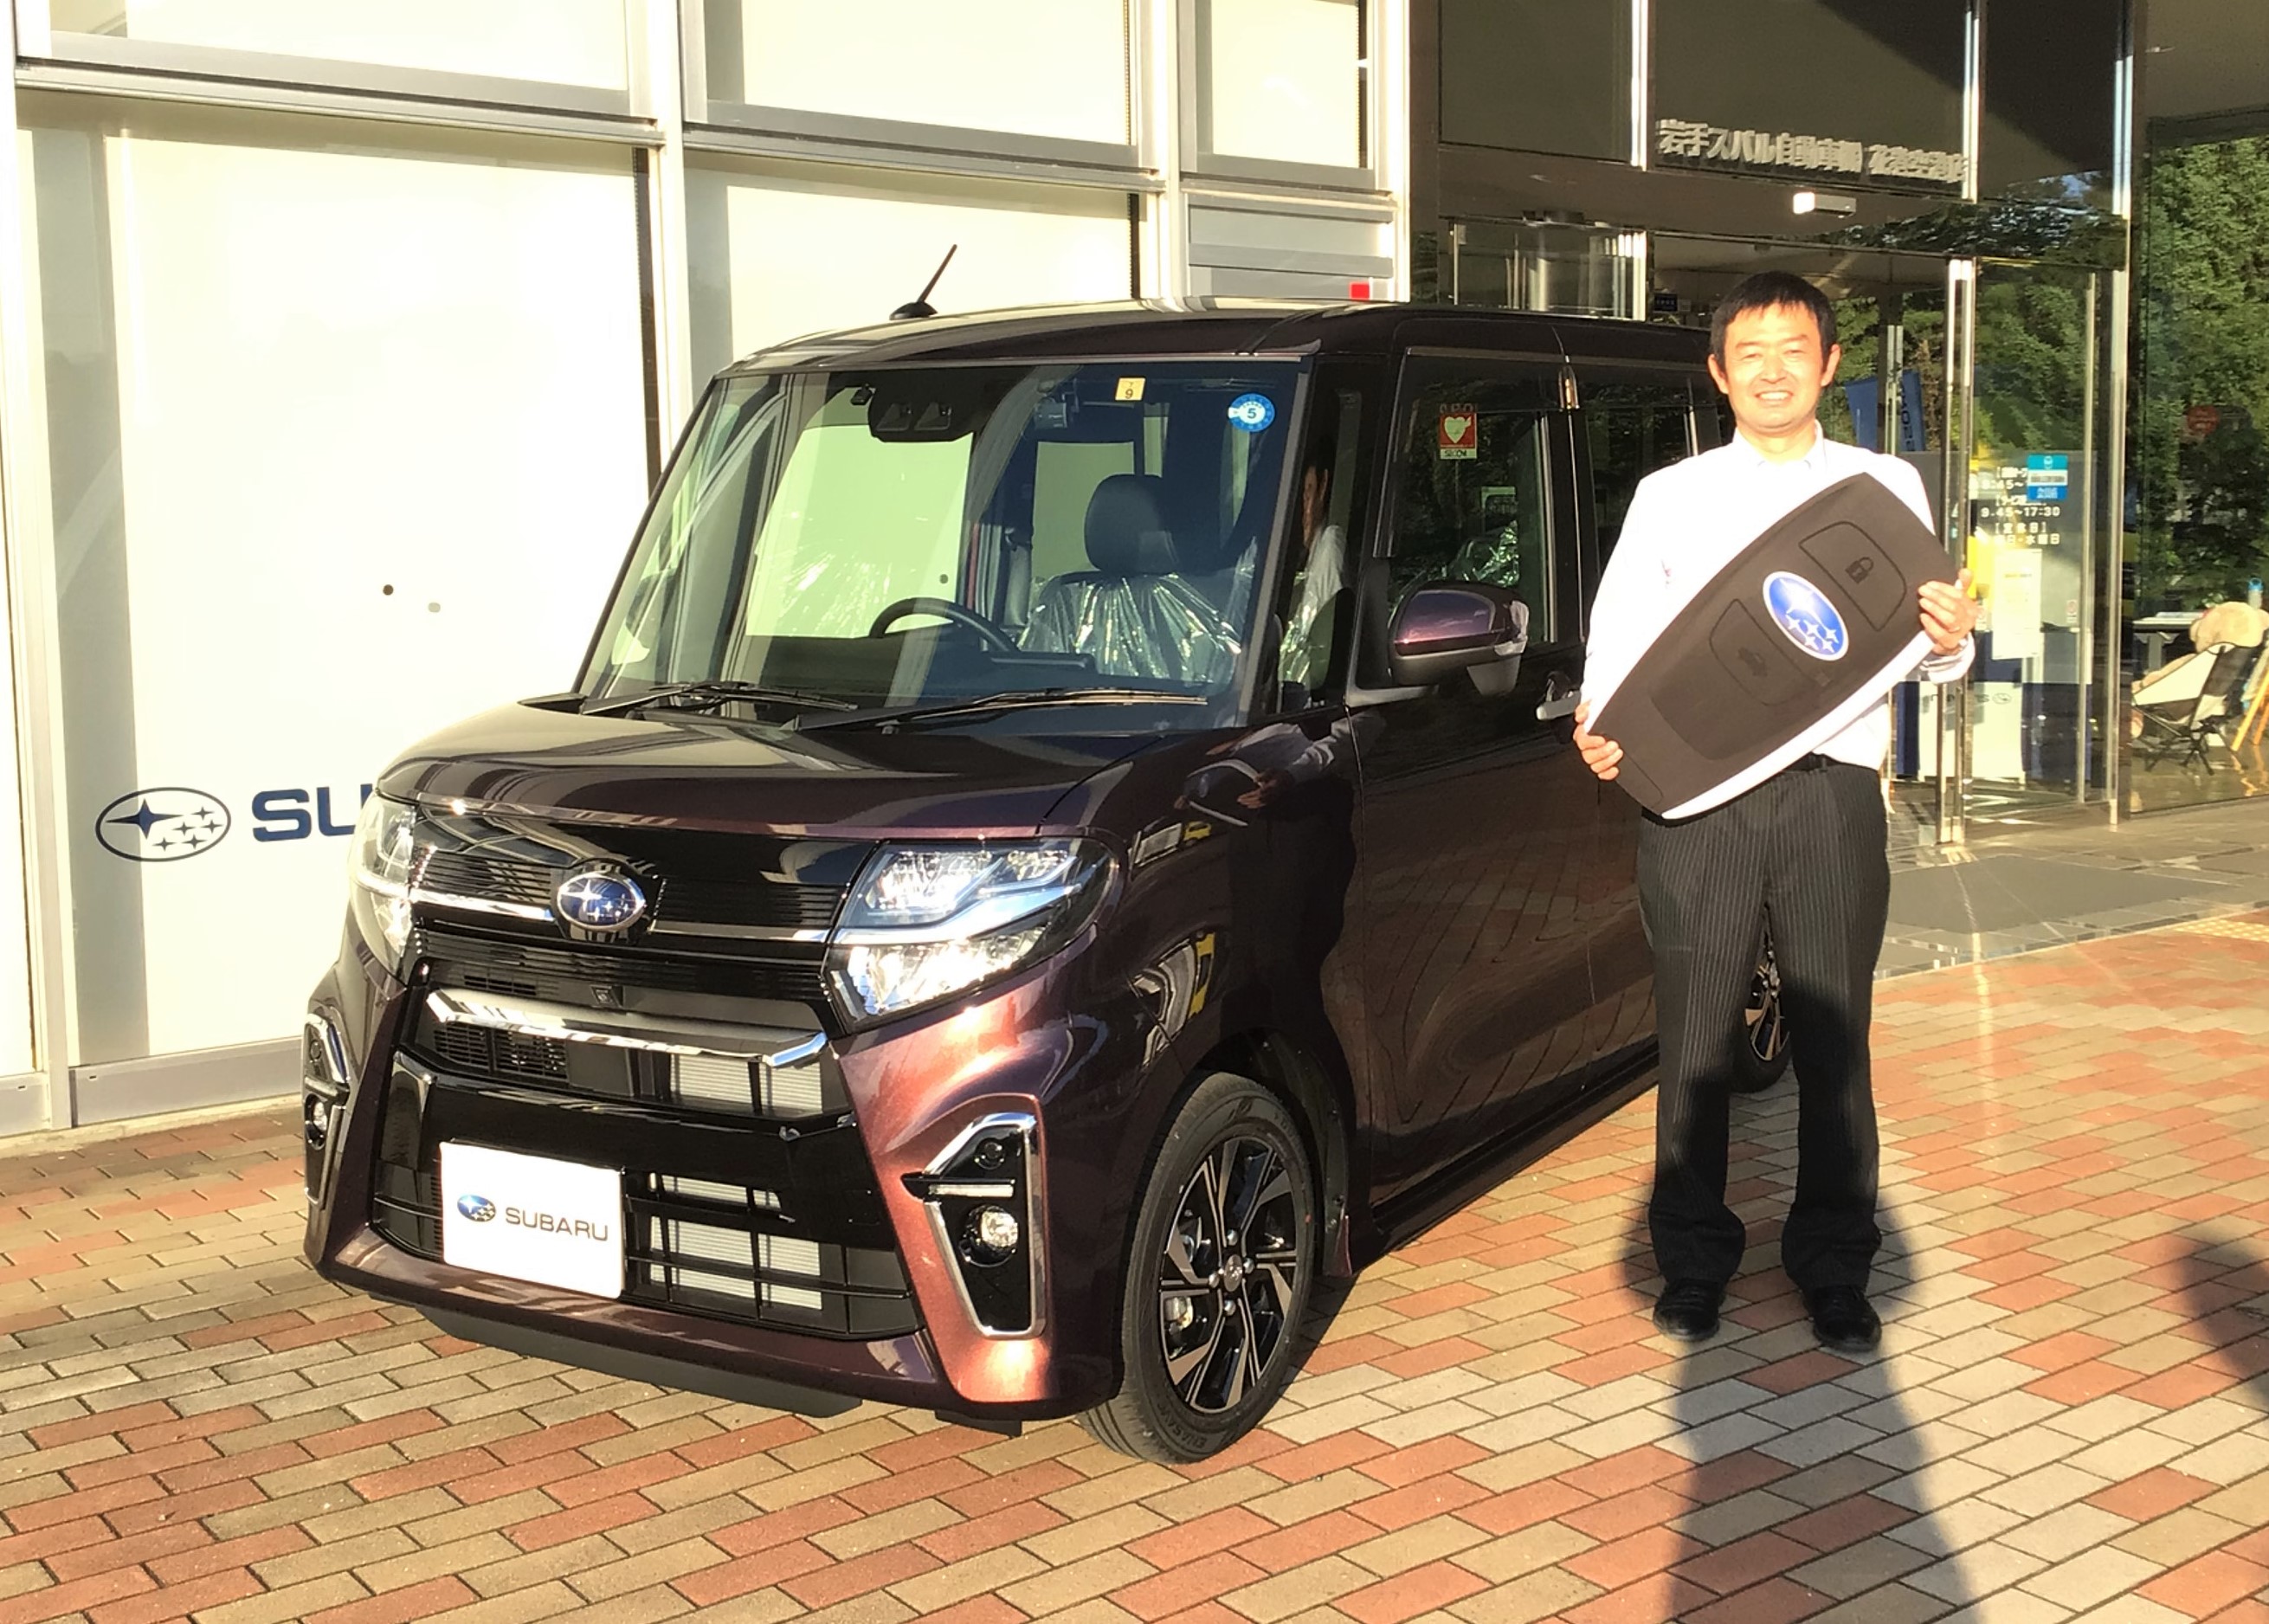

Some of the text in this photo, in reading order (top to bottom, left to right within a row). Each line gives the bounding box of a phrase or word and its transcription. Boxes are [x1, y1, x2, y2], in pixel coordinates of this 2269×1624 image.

[1125, 388, 1134, 400] 9
[1247, 407, 1257, 419] 5
[505, 1206, 609, 1242] SUBARU
